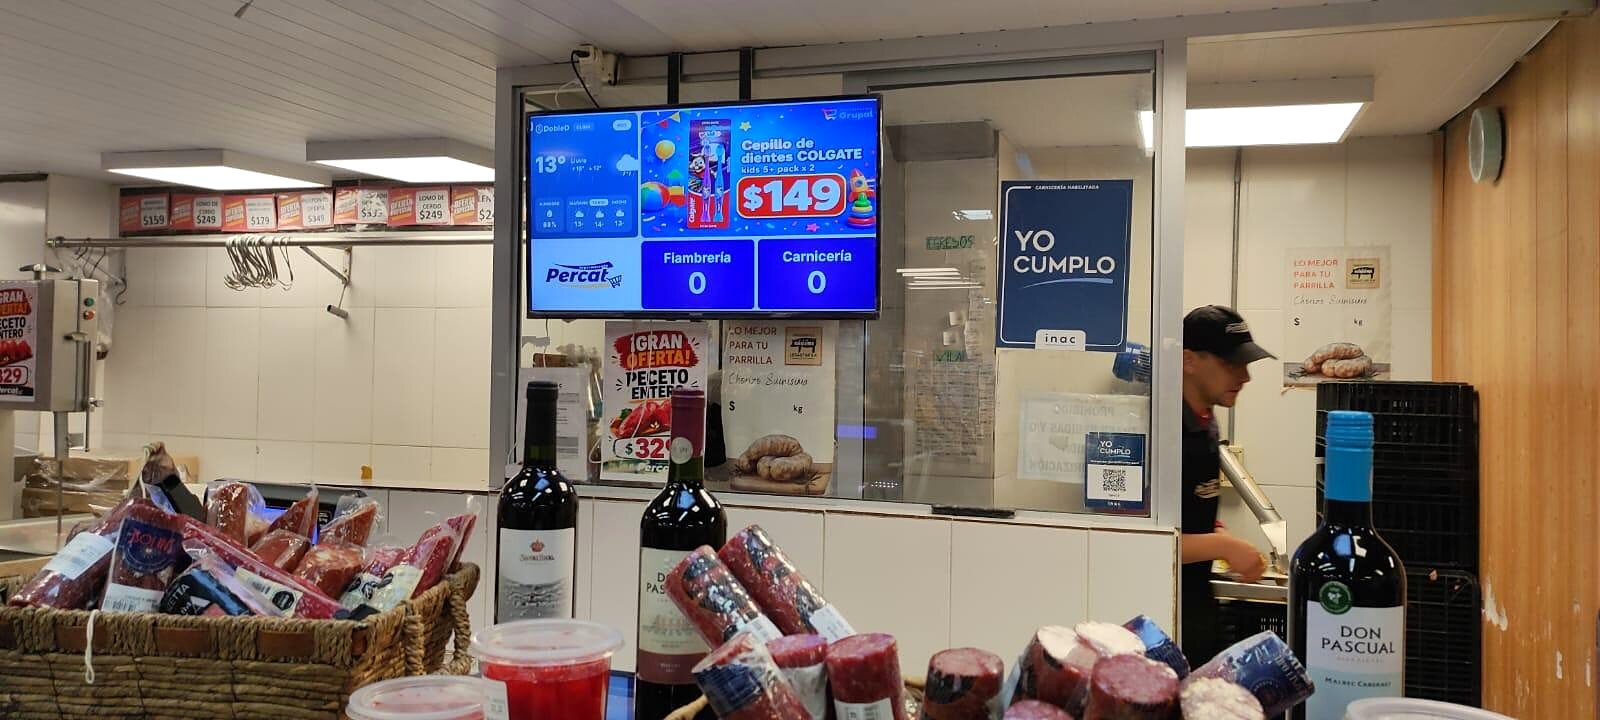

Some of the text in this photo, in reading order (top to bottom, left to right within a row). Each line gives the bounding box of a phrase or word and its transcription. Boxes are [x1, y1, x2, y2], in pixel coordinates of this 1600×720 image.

[741, 138, 814, 152] Cepillo de
[741, 148, 862, 163] dientes COLGATE
[741, 165, 760, 174] kids
[763, 165, 774, 173] 5+
[777, 165, 799, 174] pack
[809, 164, 815, 172] 2
[743, 178, 841, 212] $149
[143, 215, 165, 226] $159
[196, 215, 216, 225] $249
[251, 216, 270, 226] $179
[419, 209, 443, 220] $249
[1014, 230, 1055, 252] YO
[664, 250, 852, 264] Fiambrería Carnicería
[1307, 259, 1338, 267] MEJOR
[1013, 255, 1116, 274] CUMPLO
[546, 268, 608, 282] Percat
[688, 271, 827, 294] 0 0
[1293, 317, 1300, 326] $
[744, 326, 777, 336] MEJOR
[630, 333, 682, 350] ¡GRAN
[1045, 333, 1076, 344] inac
[729, 341, 768, 350] PARA TU
[626, 350, 690, 367] OFERTA!
[729, 355, 773, 365] PARRILLA
[626, 369, 689, 386] PECETO
[729, 401, 803, 414] $ kg
[625, 443, 633, 455] $
[638, 461, 668, 473] Perca
[1341, 625, 1381, 639] DON
[1321, 637, 1395, 654] PASCUAL
